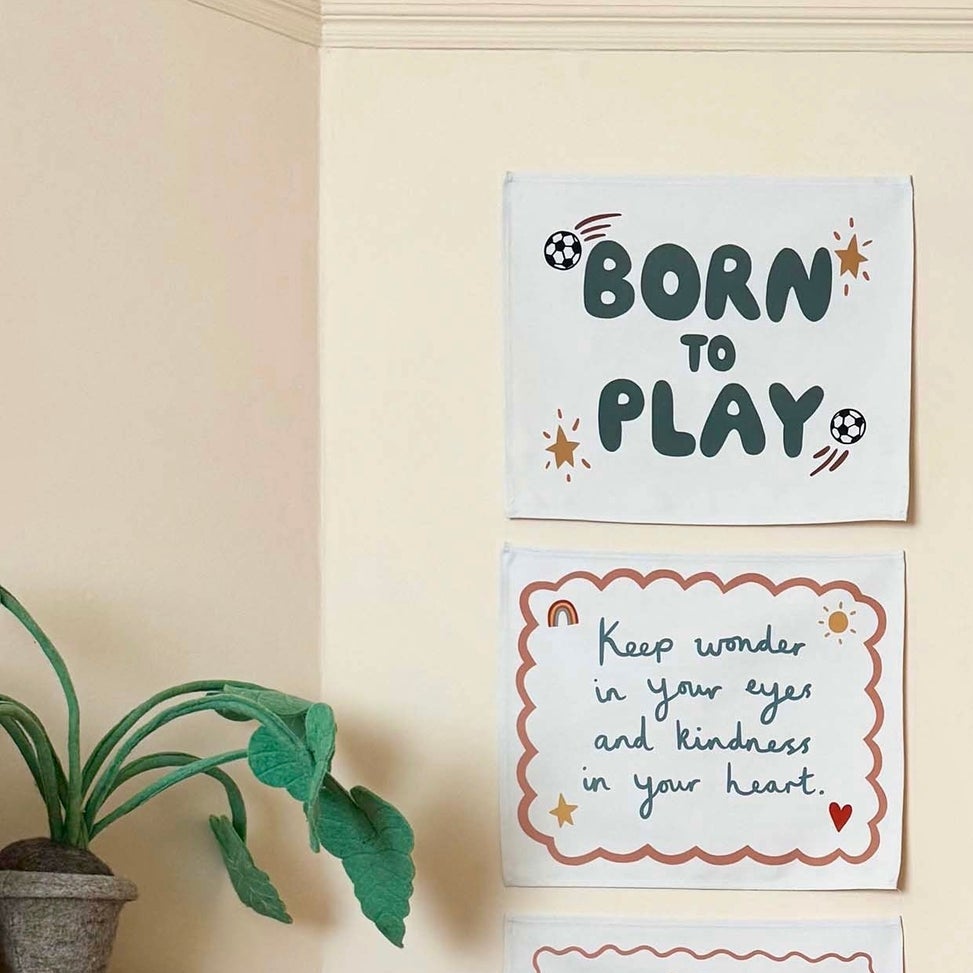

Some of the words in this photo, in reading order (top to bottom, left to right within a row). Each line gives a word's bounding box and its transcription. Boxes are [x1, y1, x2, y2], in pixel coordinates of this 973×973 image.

[583, 240, 832, 322] BORN
[680, 334, 736, 372] TO
[598, 378, 824, 458] PLAY
[599, 617, 673, 666] Keep
[694, 624, 806, 657] wonder
[594, 678, 627, 703] in
[647, 678, 722, 722] your
[745, 679, 812, 725] eyes
[594, 715, 654, 751] and
[676, 720, 811, 755] kindness
[582, 766, 610, 792] in
[634, 774, 700, 819] your
[726, 762, 825, 796] heart.
